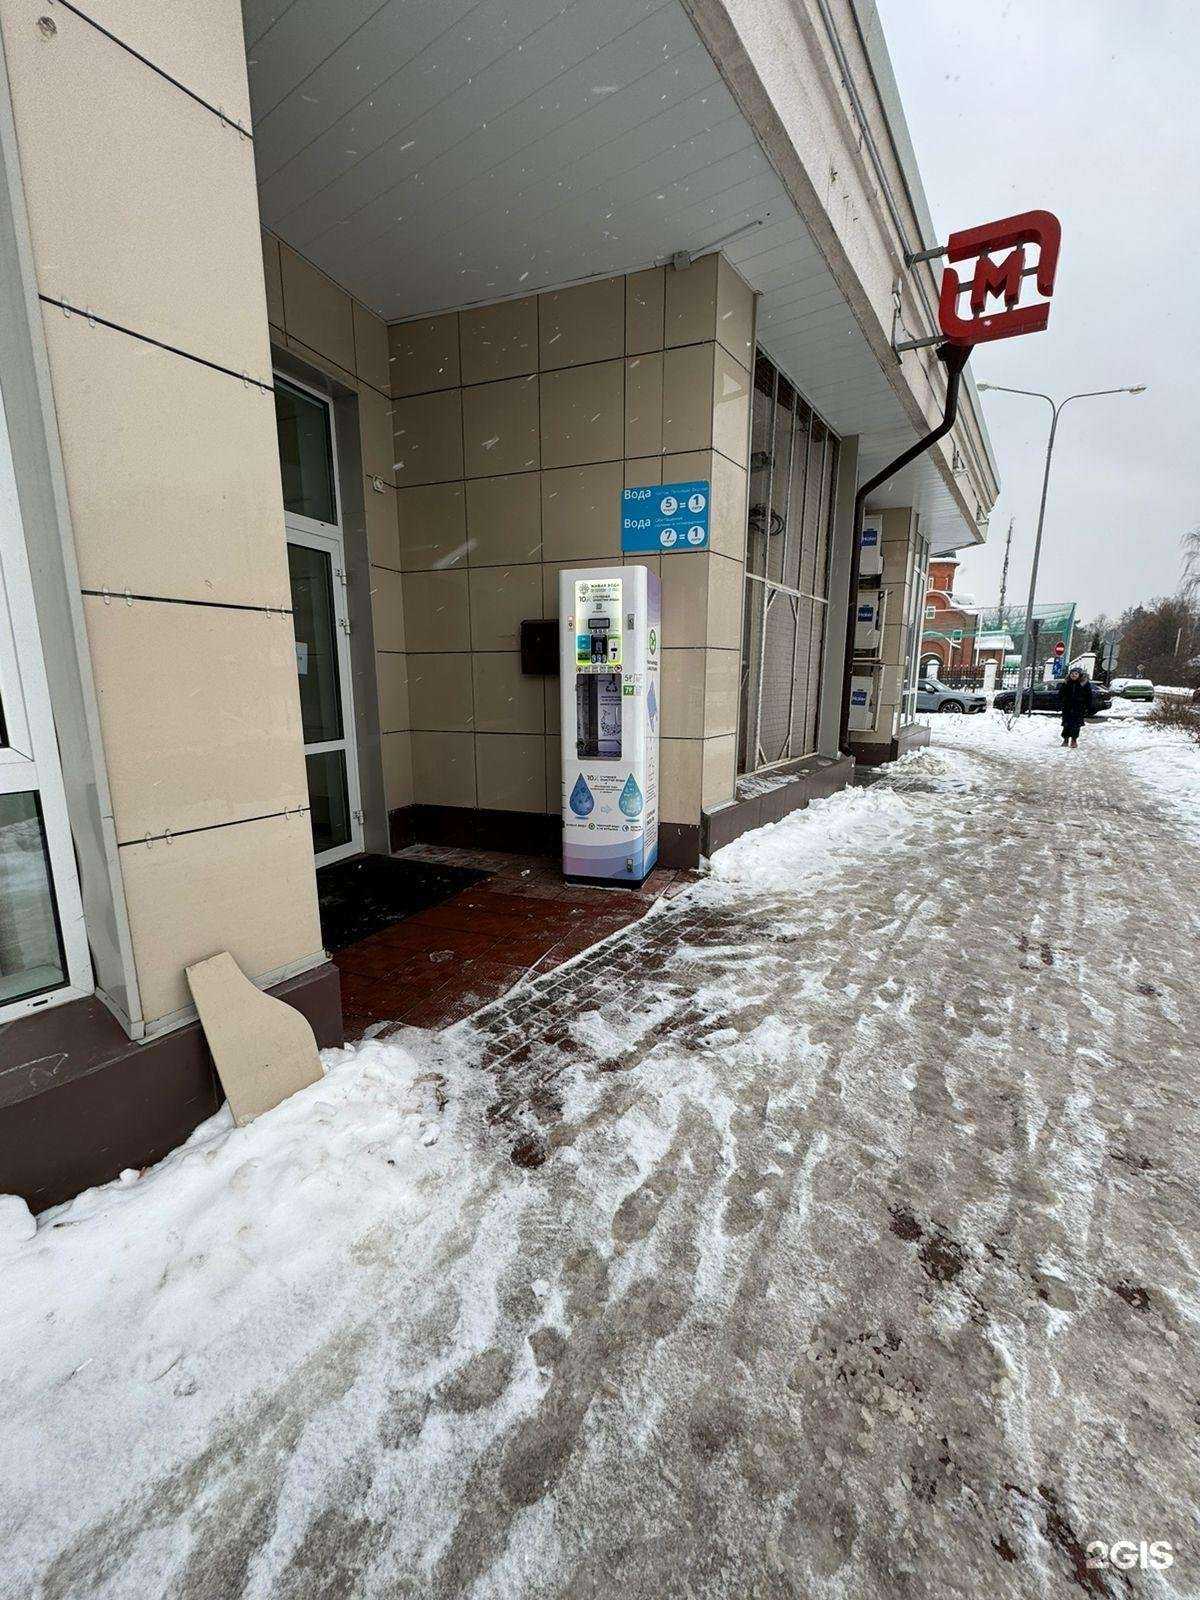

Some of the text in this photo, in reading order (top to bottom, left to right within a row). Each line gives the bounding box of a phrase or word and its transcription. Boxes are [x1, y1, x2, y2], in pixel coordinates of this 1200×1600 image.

[624, 489, 652, 500] Вода
[665, 498, 672, 508] 5
[693, 495, 699, 505] 1
[624, 518, 651, 530] Вода
[664, 530, 672, 540] 7
[692, 527, 699, 537] 1
